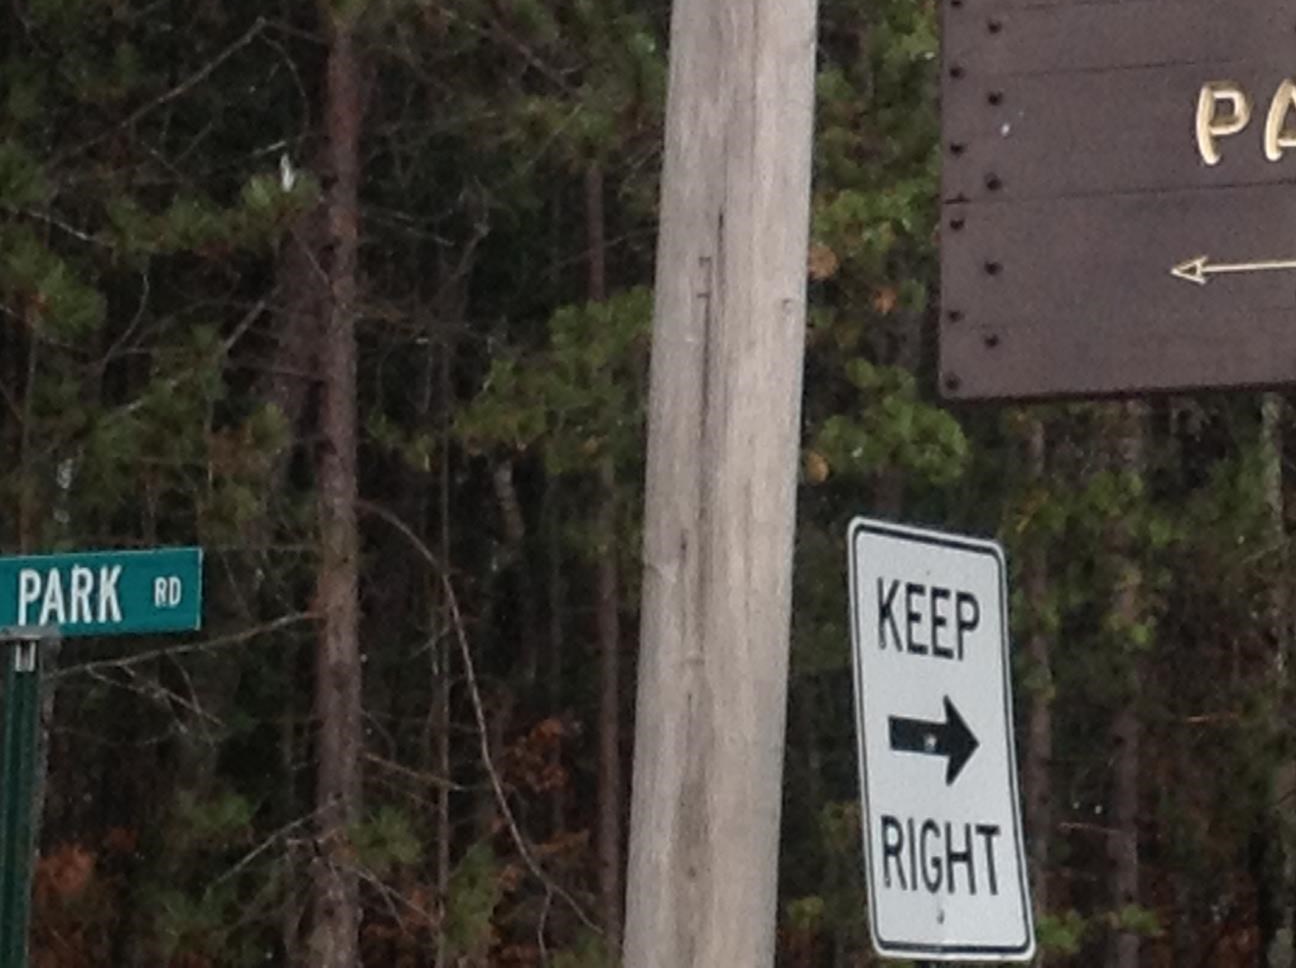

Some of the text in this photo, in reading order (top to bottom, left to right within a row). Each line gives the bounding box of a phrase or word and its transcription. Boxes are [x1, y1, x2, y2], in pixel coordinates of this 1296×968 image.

[18, 563, 182, 626] PARK RD
[877, 576, 981, 661] KEEP
[881, 815, 1000, 896] RIGHT
